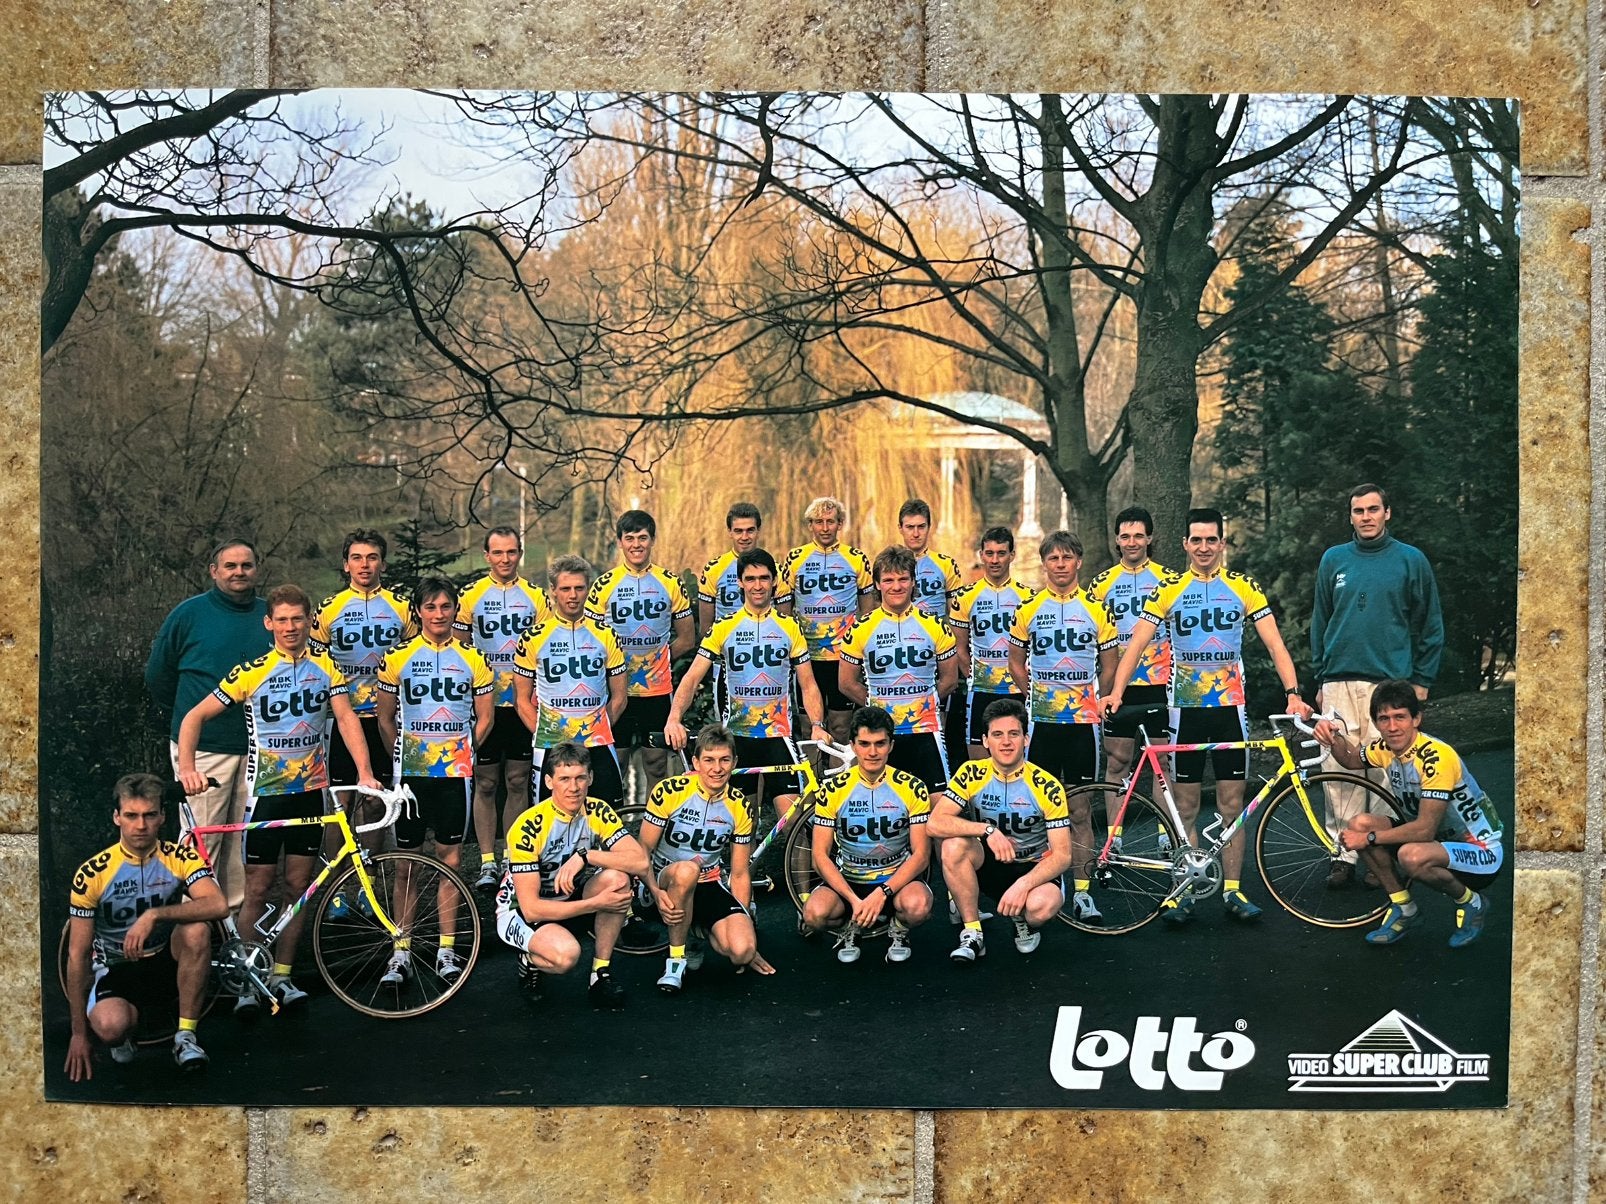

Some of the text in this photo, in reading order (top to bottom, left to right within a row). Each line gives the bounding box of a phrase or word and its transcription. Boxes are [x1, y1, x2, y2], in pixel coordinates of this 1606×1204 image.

[804, 606, 846, 615] SUPER CLUB
[1146, 614, 1160, 625] CLUB
[644, 637, 662, 646] CLUB
[845, 654, 859, 665] CLUB
[978, 650, 1002, 659] SUPER
[1182, 651, 1235, 662] SUPER CLUB
[344, 665, 371, 675] SUPER
[269, 676, 291, 684] MBK
[1037, 671, 1088, 680] SUPER CLUB
[382, 685, 397, 694] CLUB
[735, 686, 782, 696] SUPER CLUB
[877, 685, 929, 696] SUPER CLUB
[550, 697, 602, 707] SUPER CLUB
[411, 721, 464, 732] SUPER CLUB
[245, 704, 257, 782] SUPER CLUB
[268, 733, 321, 749] SUPER CLUB
[1244, 741, 1264, 749] MBK
[1156, 773, 1168, 793] MBK
[981, 793, 1001, 802] MBK
[1432, 791, 1449, 800] CLUB
[980, 800, 1001, 808] MAVIC
[681, 806, 701, 817] MBK
[301, 816, 322, 824] MBK
[652, 816, 666, 828] CLUB
[679, 813, 701, 823] MAVIC
[821, 818, 836, 828] CLUB
[910, 816, 928, 825] SUPER
[606, 830, 624, 847] SUPER
[1209, 838, 1227, 855] MBK
[848, 854, 880, 868] SUPER
[1453, 848, 1497, 864] SUPER CLUB
[512, 864, 530, 873] SUPER
[186, 869, 207, 886] SUPER
[114, 880, 138, 888] MBK
[77, 907, 95, 918] CLUB
[1288, 1053, 1488, 1075] VIDEO SUPER CLUB FILM
